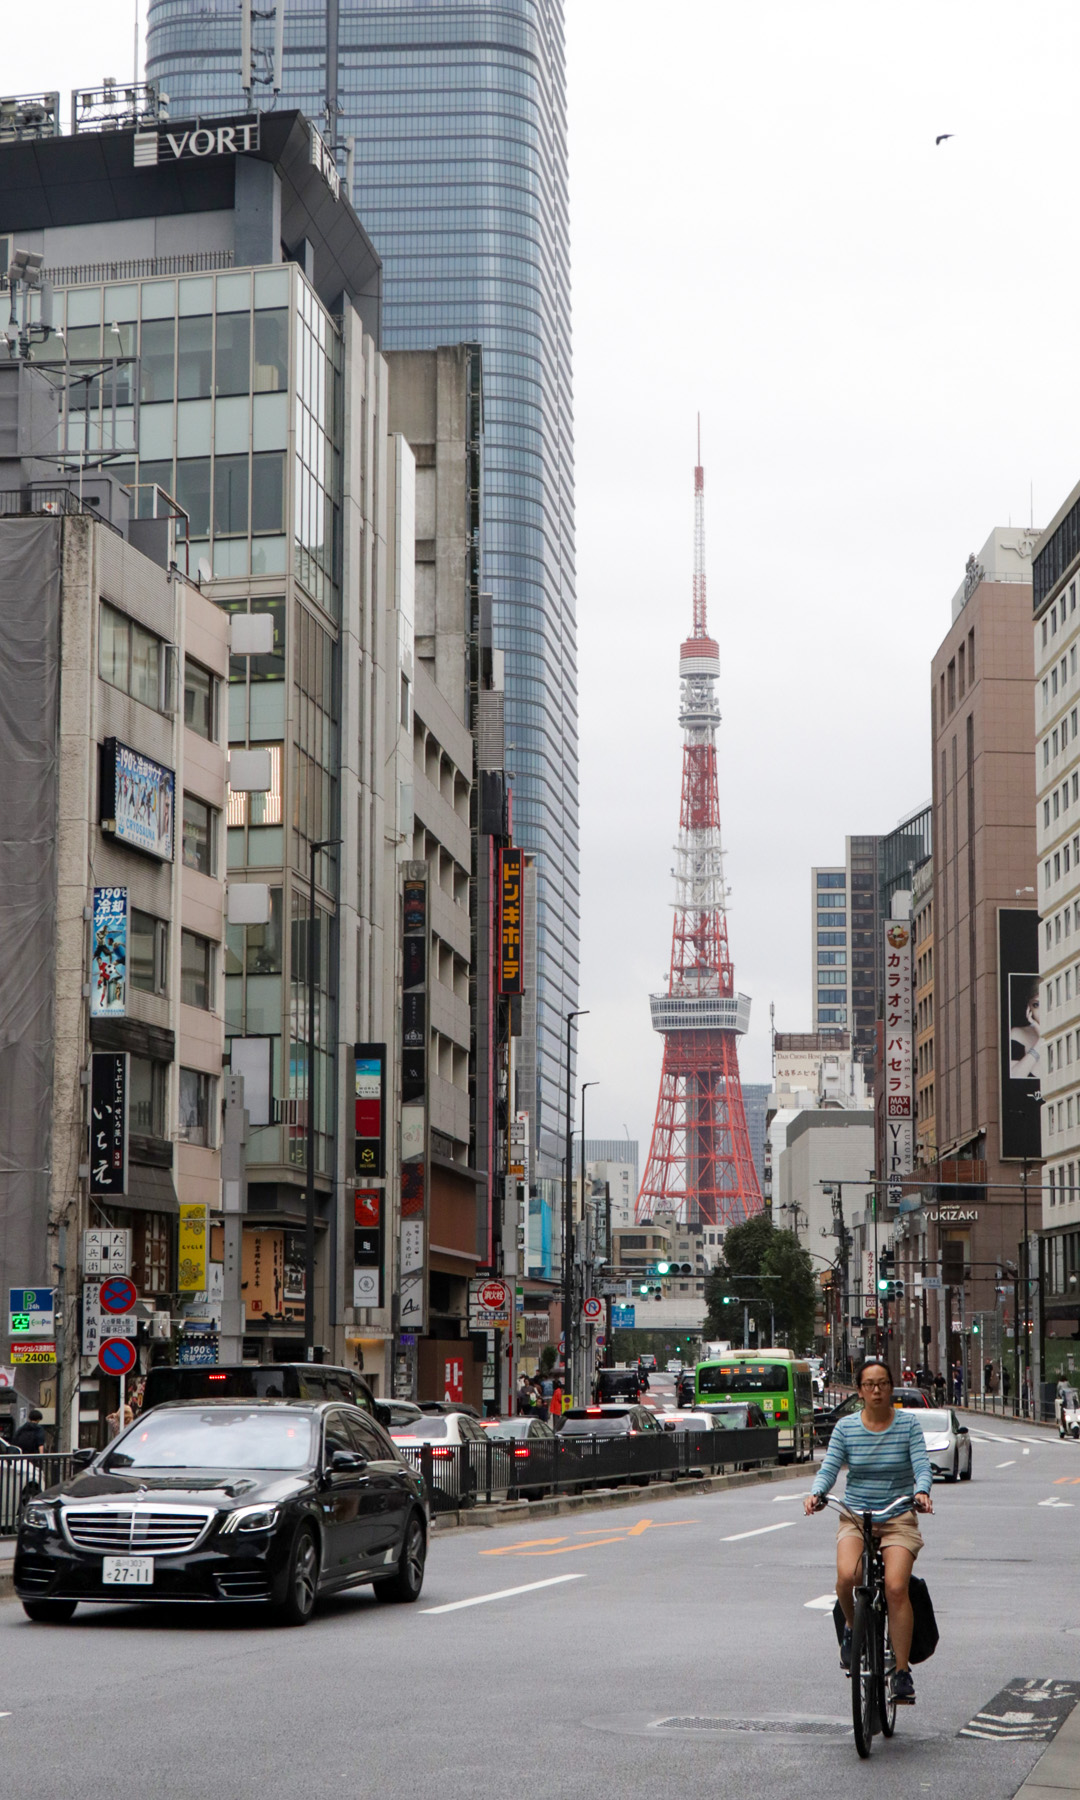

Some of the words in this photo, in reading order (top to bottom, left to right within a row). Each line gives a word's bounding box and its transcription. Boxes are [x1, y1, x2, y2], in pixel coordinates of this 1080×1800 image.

[166, 123, 258, 158] VORT
[97, 899, 124, 914] 冷却
[94, 914, 127, 927] サウナ
[888, 953, 902, 1028] カラオケ
[903, 955, 911, 1024] KARAOKE
[888, 1037, 903, 1092] パセラ
[903, 1040, 911, 1089] PASELA
[113, 1059, 123, 1103] しゃぶしゃぶ
[890, 1097, 909, 1105] MAX
[93, 1105, 112, 1184] いちえ
[922, 1210, 979, 1221] YUKIZAKI
[23, 1291, 36, 1310] P
[484, 1289, 504, 1300] 消火栓
[12, 1313, 30, 1332] 空
[114, 1568, 148, 1582] 27-11
